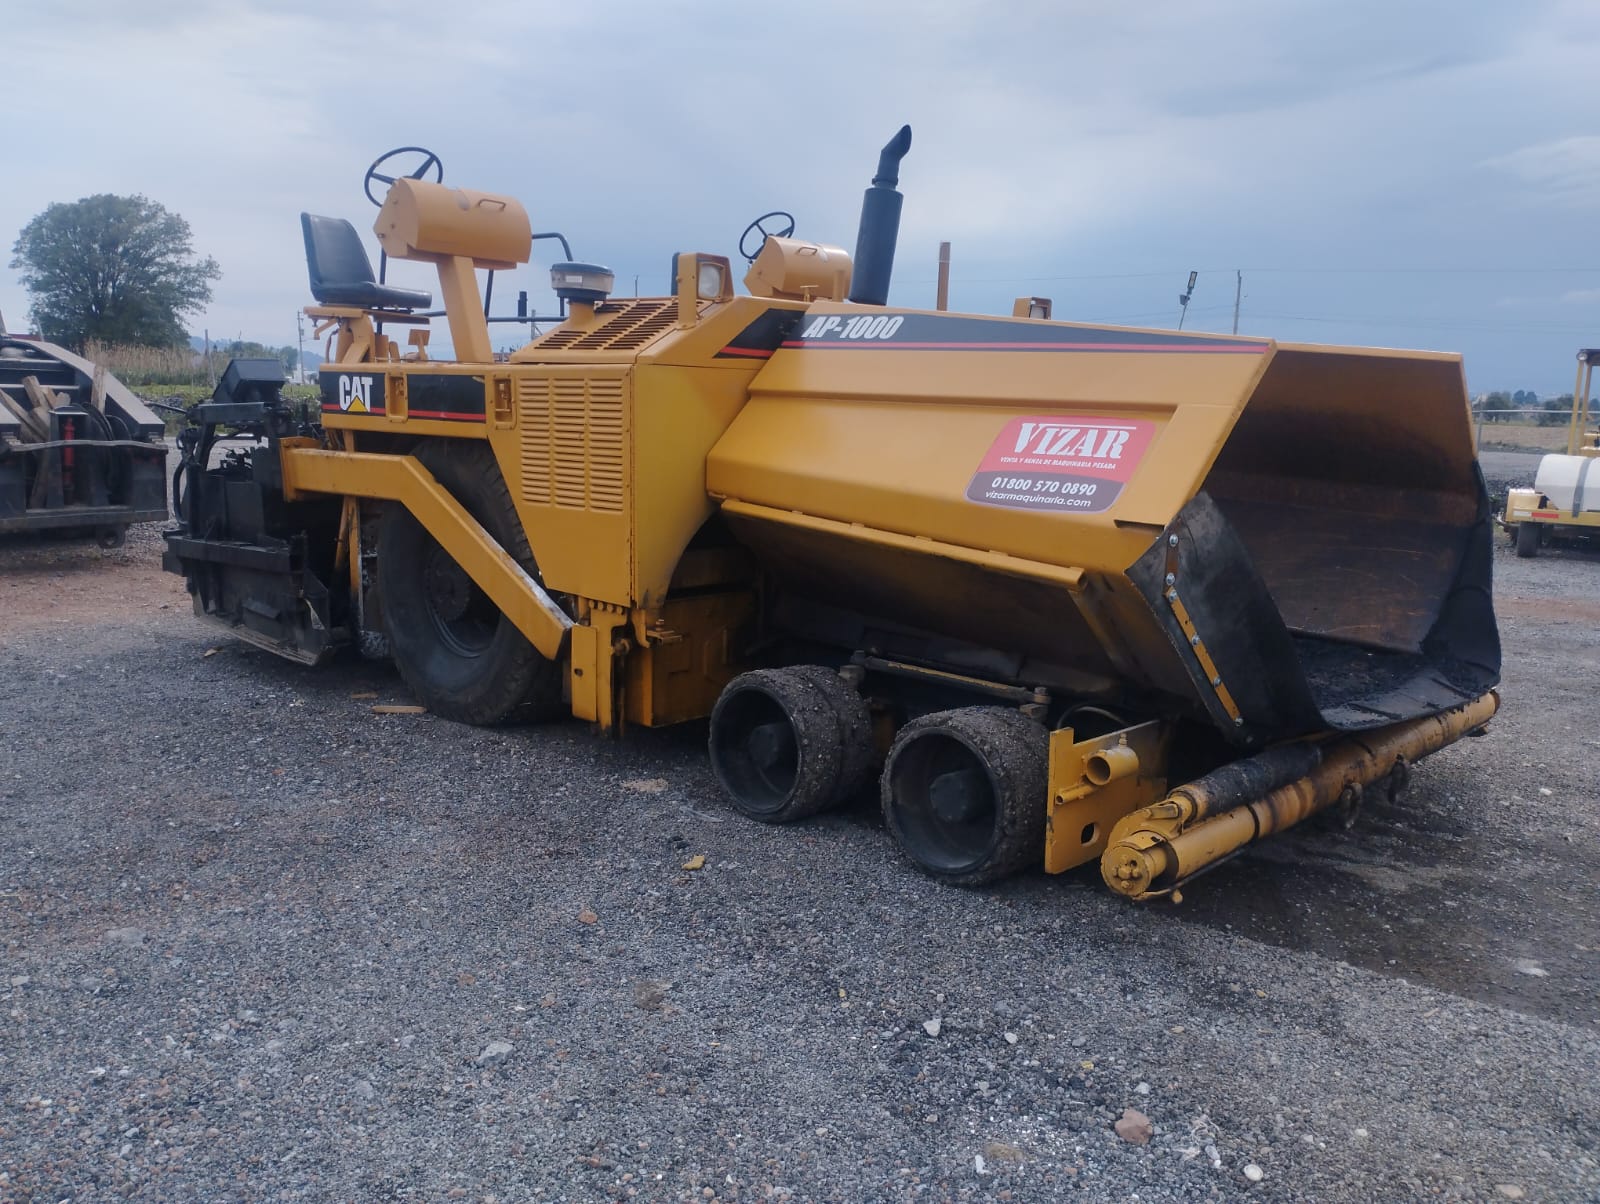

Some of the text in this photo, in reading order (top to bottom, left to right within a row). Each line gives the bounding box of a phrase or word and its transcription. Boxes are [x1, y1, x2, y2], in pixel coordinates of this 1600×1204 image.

[801, 316, 904, 339] AP-1000
[339, 374, 373, 412] CAT
[1014, 423, 1131, 459] VIZAR
[1052, 459, 1092, 468] MAQUINARIA
[992, 477, 1097, 496] 01800 570 0890
[984, 490, 1092, 508] vizarmaquinaria.com
